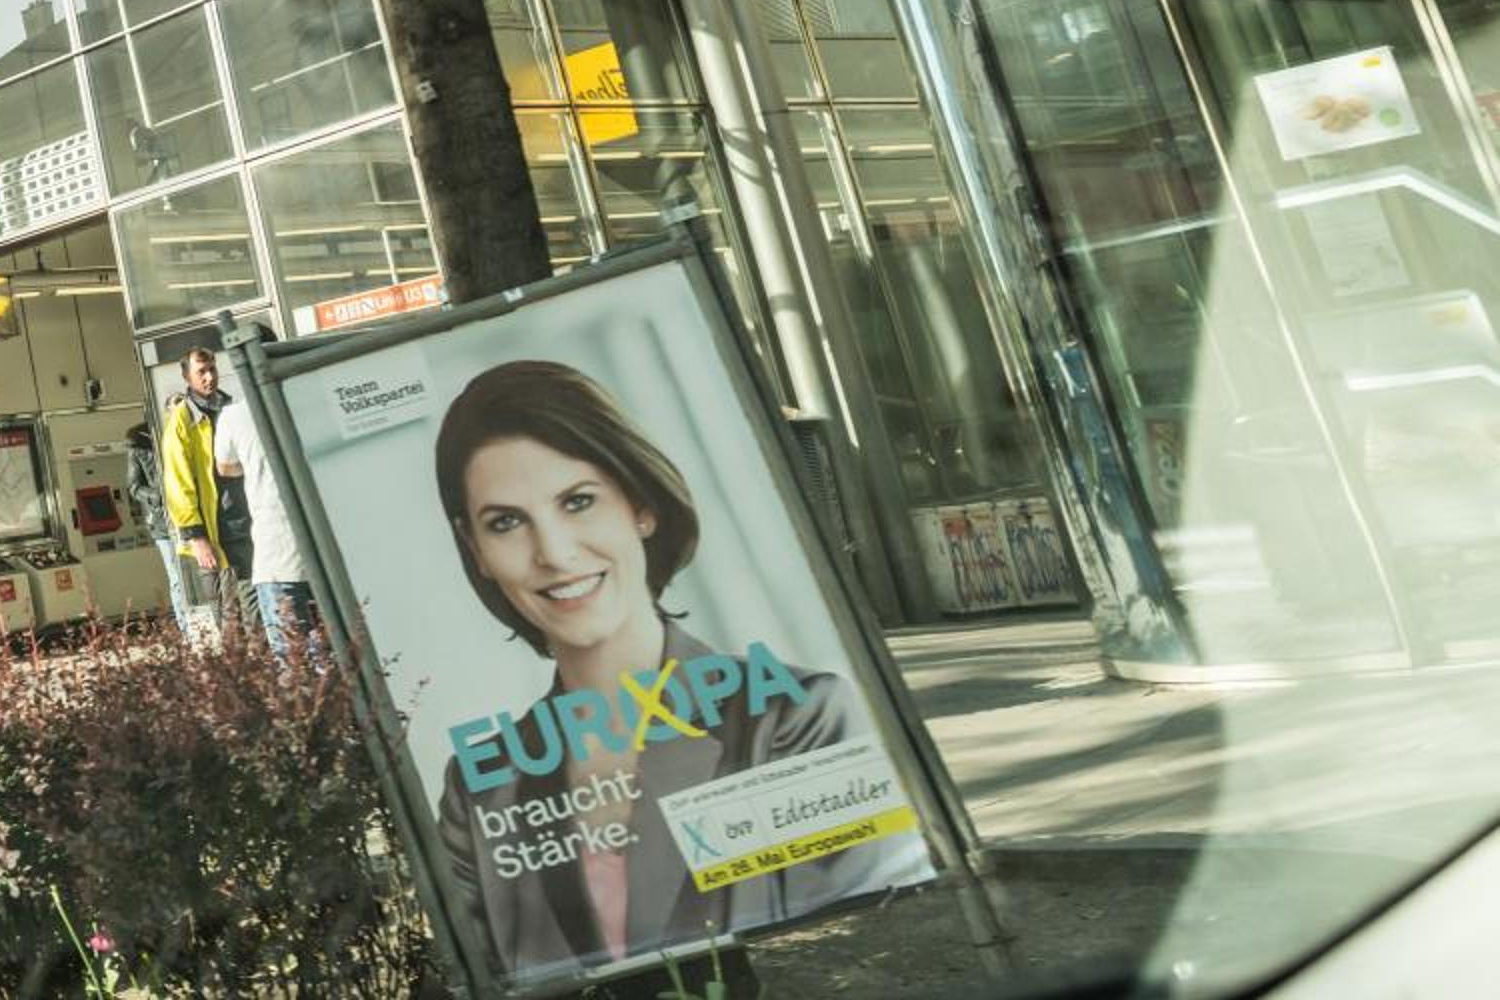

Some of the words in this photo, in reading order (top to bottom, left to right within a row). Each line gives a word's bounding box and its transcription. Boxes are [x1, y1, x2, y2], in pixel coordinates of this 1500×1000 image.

[334, 381, 379, 400] Team
[449, 640, 804, 793] EUROPA
[476, 769, 642, 839] braucht
[771, 777, 892, 829] Edtstadler
[493, 822, 639, 879] Stärke.
